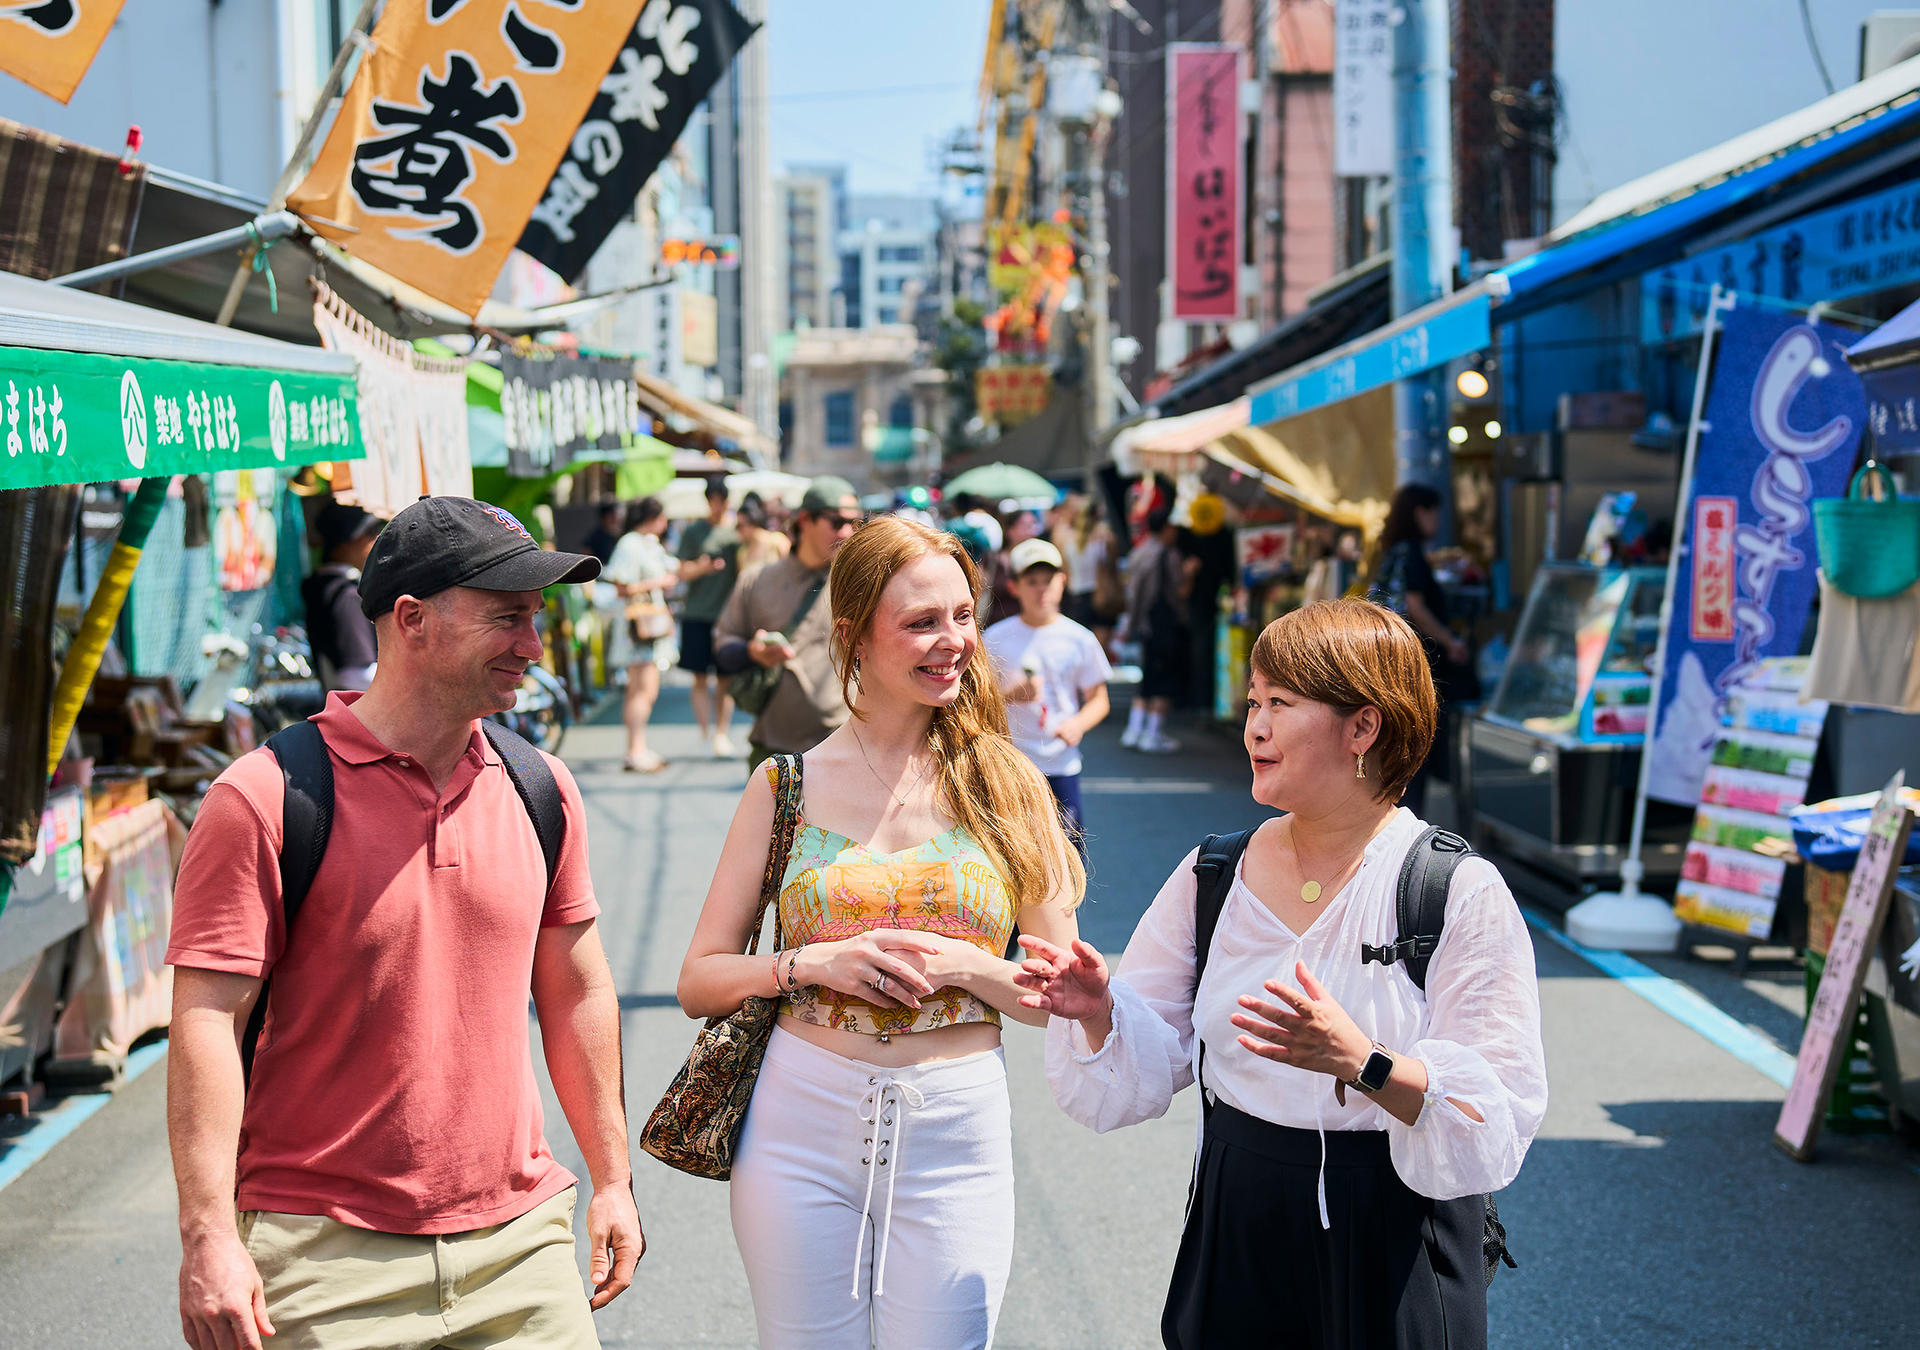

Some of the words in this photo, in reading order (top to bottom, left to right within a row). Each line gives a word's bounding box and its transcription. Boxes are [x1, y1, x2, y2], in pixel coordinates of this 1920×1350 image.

[1369, 0, 1389, 56] 商店
[351, 0, 585, 257] 煮
[0, 379, 67, 458] まはち
[154, 394, 184, 446] 築地
[187, 389, 240, 453] やまはち
[310, 394, 349, 447] やまはち
